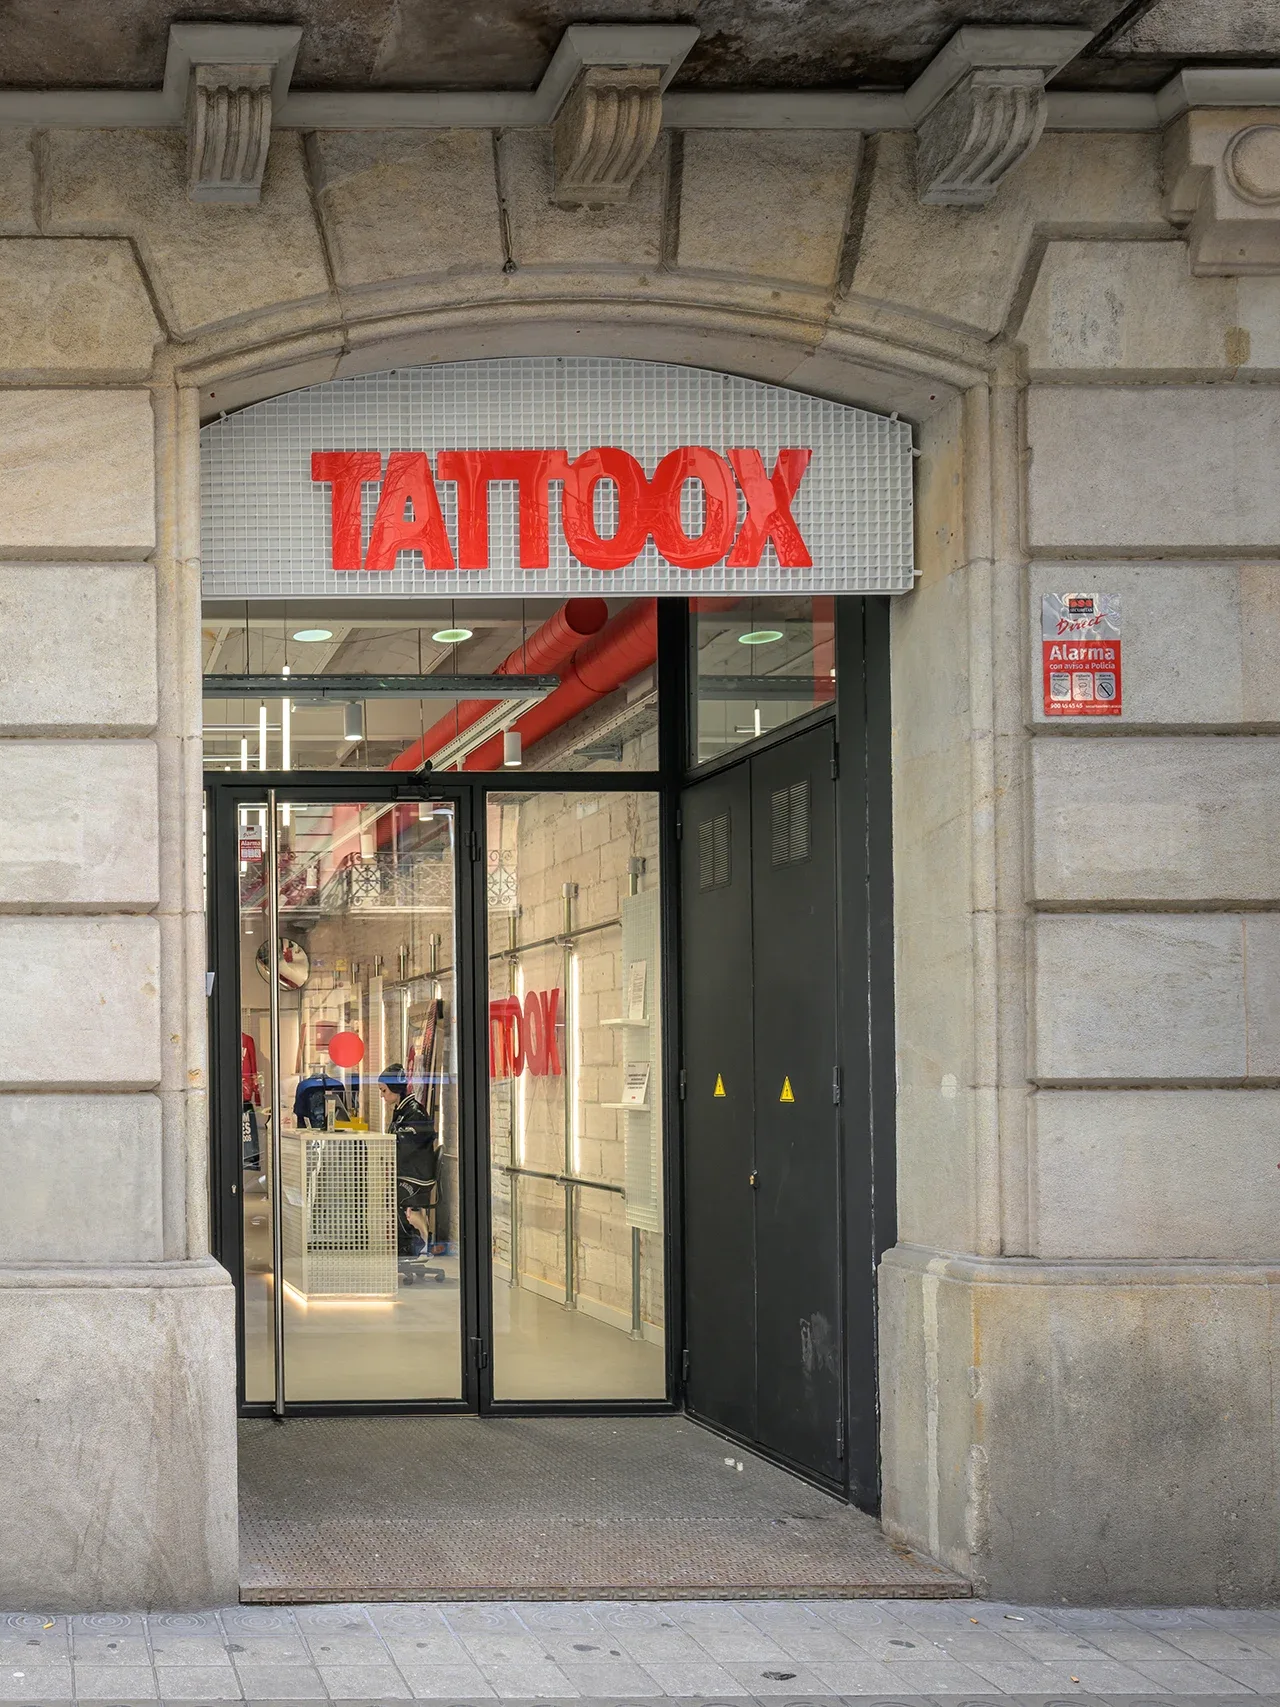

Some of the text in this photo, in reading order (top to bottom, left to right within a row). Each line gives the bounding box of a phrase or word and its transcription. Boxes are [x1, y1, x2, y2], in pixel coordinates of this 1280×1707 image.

[311, 447, 813, 570] TATTOOX
[1056, 612, 1108, 635] Direct
[1049, 644, 1115, 661] Alarma
[1064, 661, 1083, 670] aviso
[1091, 661, 1115, 670] Policía
